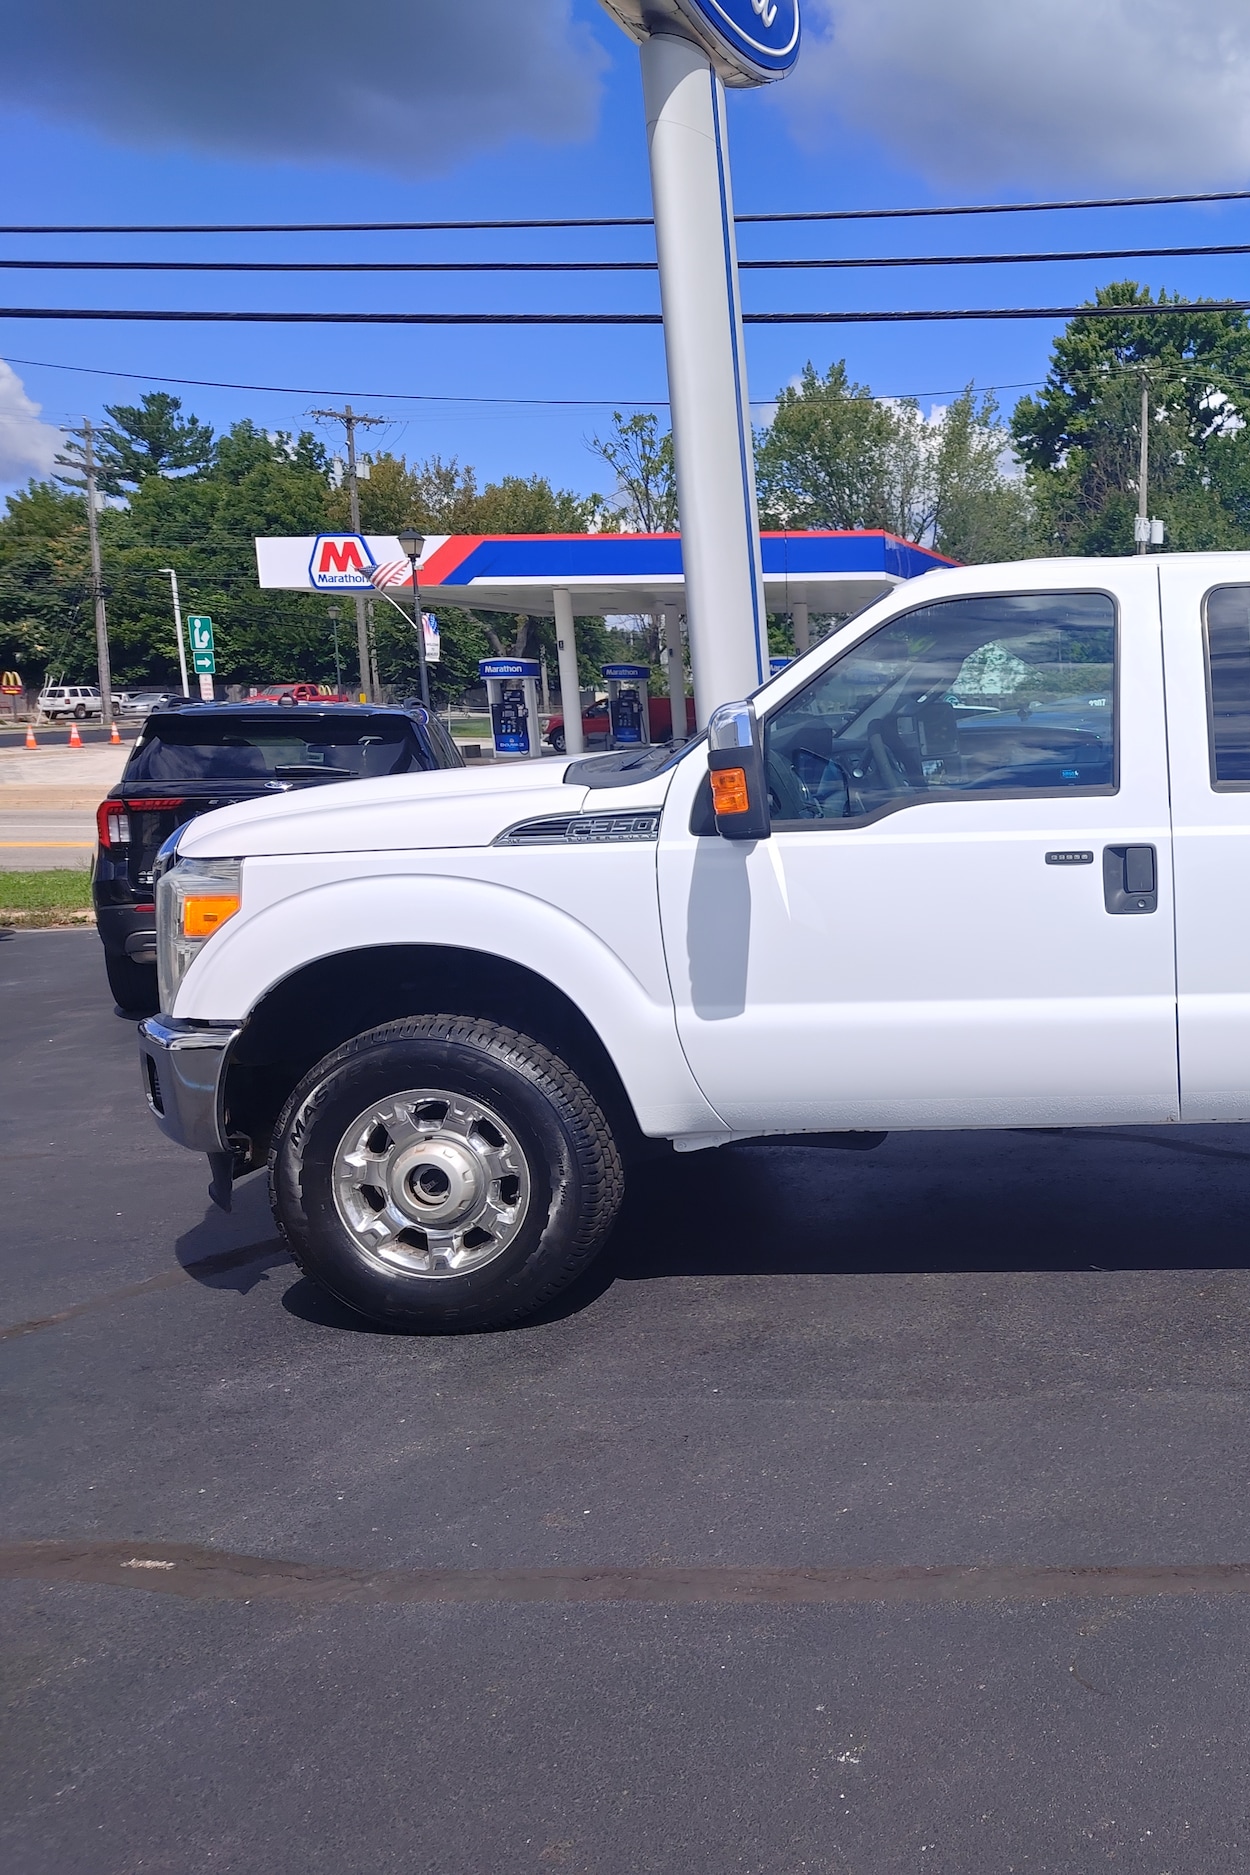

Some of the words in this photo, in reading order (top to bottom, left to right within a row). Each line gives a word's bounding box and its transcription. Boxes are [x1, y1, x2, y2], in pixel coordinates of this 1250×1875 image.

[319, 541, 364, 572] M
[484, 664, 523, 673] Marathon
[605, 668, 639, 676] Marathon
